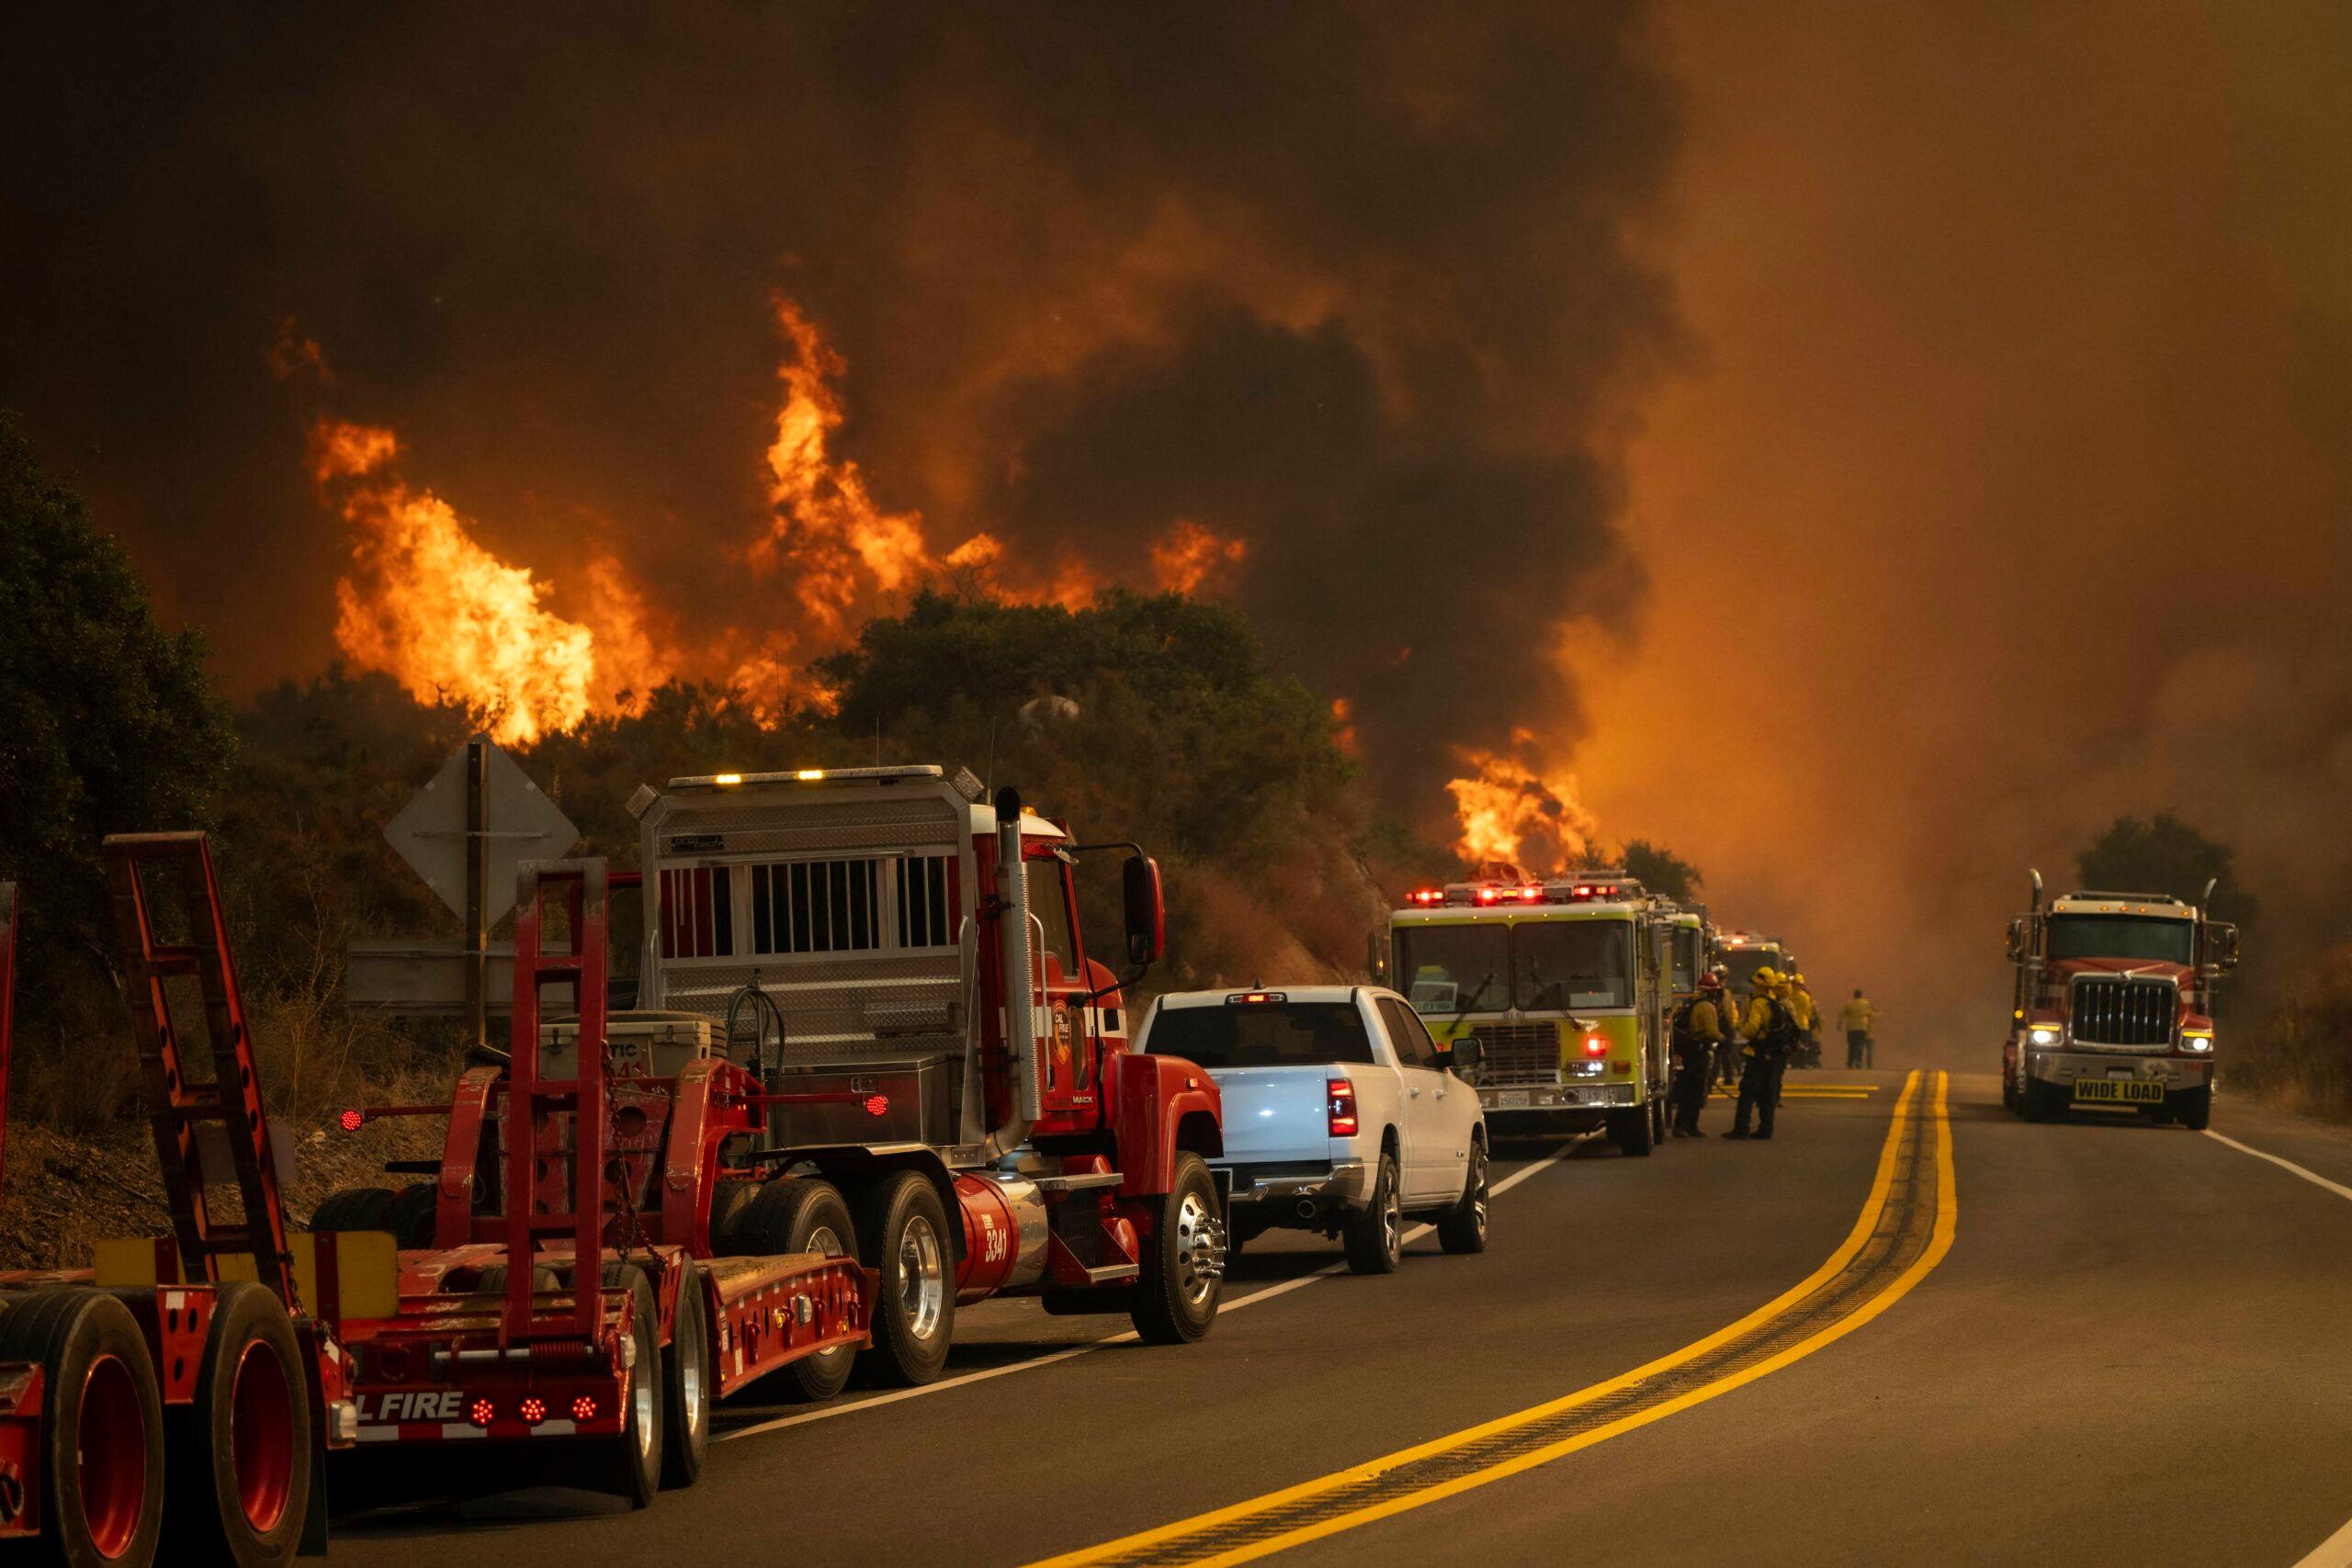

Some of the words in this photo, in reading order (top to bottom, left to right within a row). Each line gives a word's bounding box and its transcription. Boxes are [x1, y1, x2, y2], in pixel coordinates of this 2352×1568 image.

[1055, 1013, 1063, 1023] CAL
[1072, 1096, 1092, 1104] MACK
[2078, 1081, 2117, 1098] WIDE
[2124, 1083, 2161, 1100] LOAD
[986, 1227, 1007, 1263] 3341
[378, 1391, 464, 1420] FIRE
